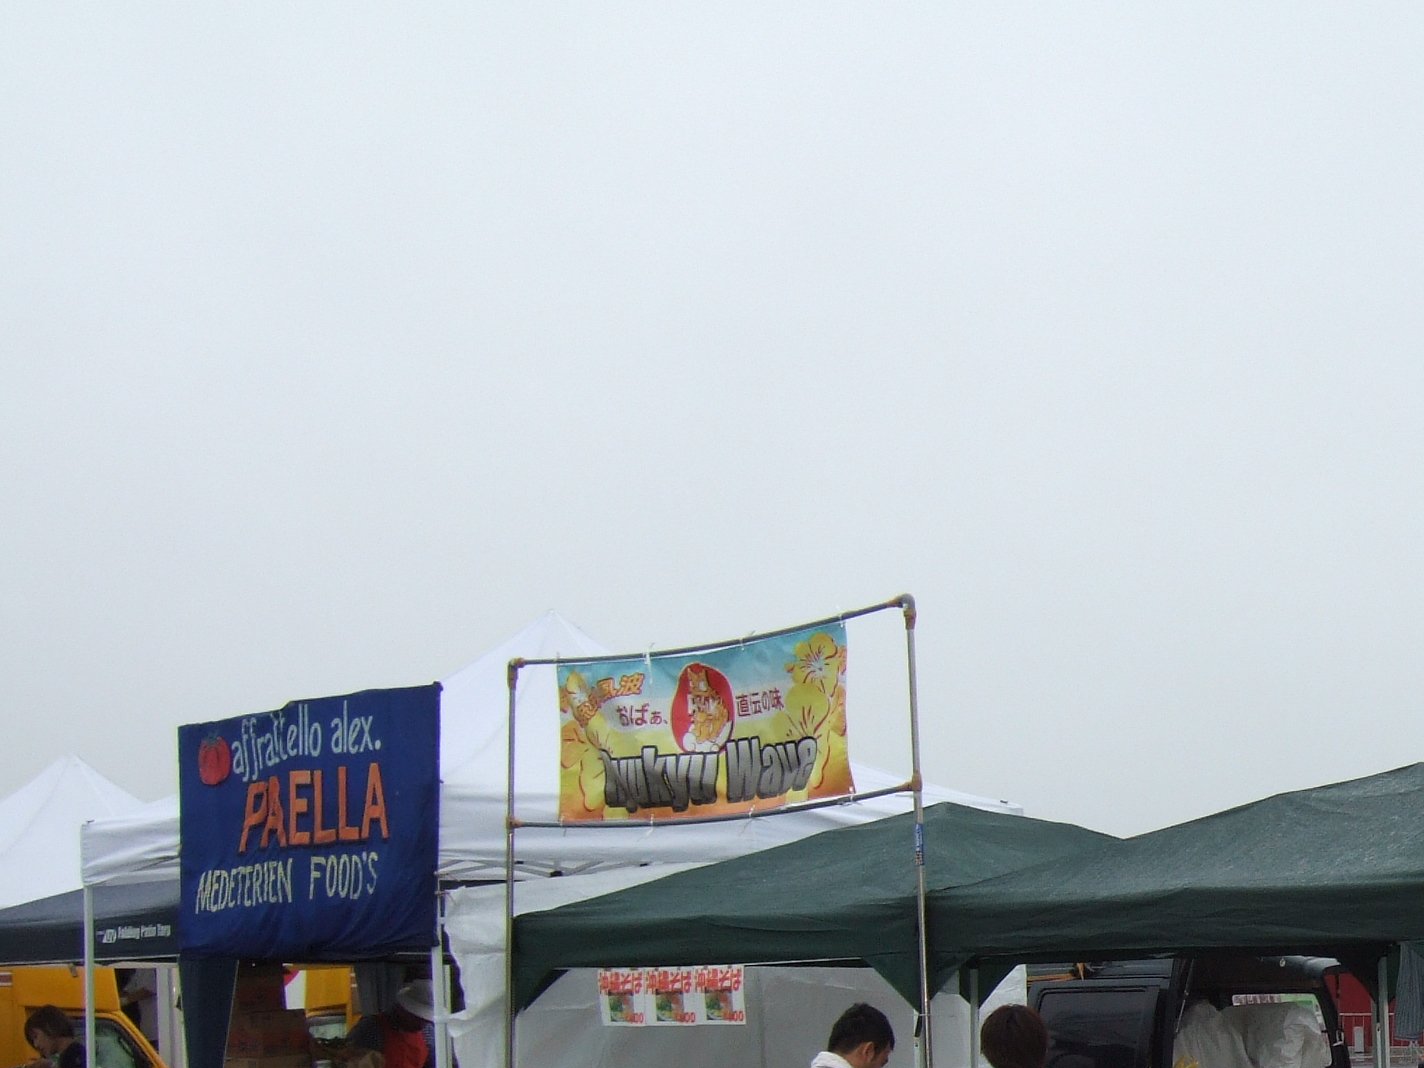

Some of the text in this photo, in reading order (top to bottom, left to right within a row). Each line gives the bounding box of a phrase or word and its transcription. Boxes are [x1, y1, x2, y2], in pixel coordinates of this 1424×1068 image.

[331, 700, 382, 754] alex.
[726, 735, 818, 804] Wave
[238, 762, 389, 852] PAELLA
[309, 852, 379, 900] FOOD'S
